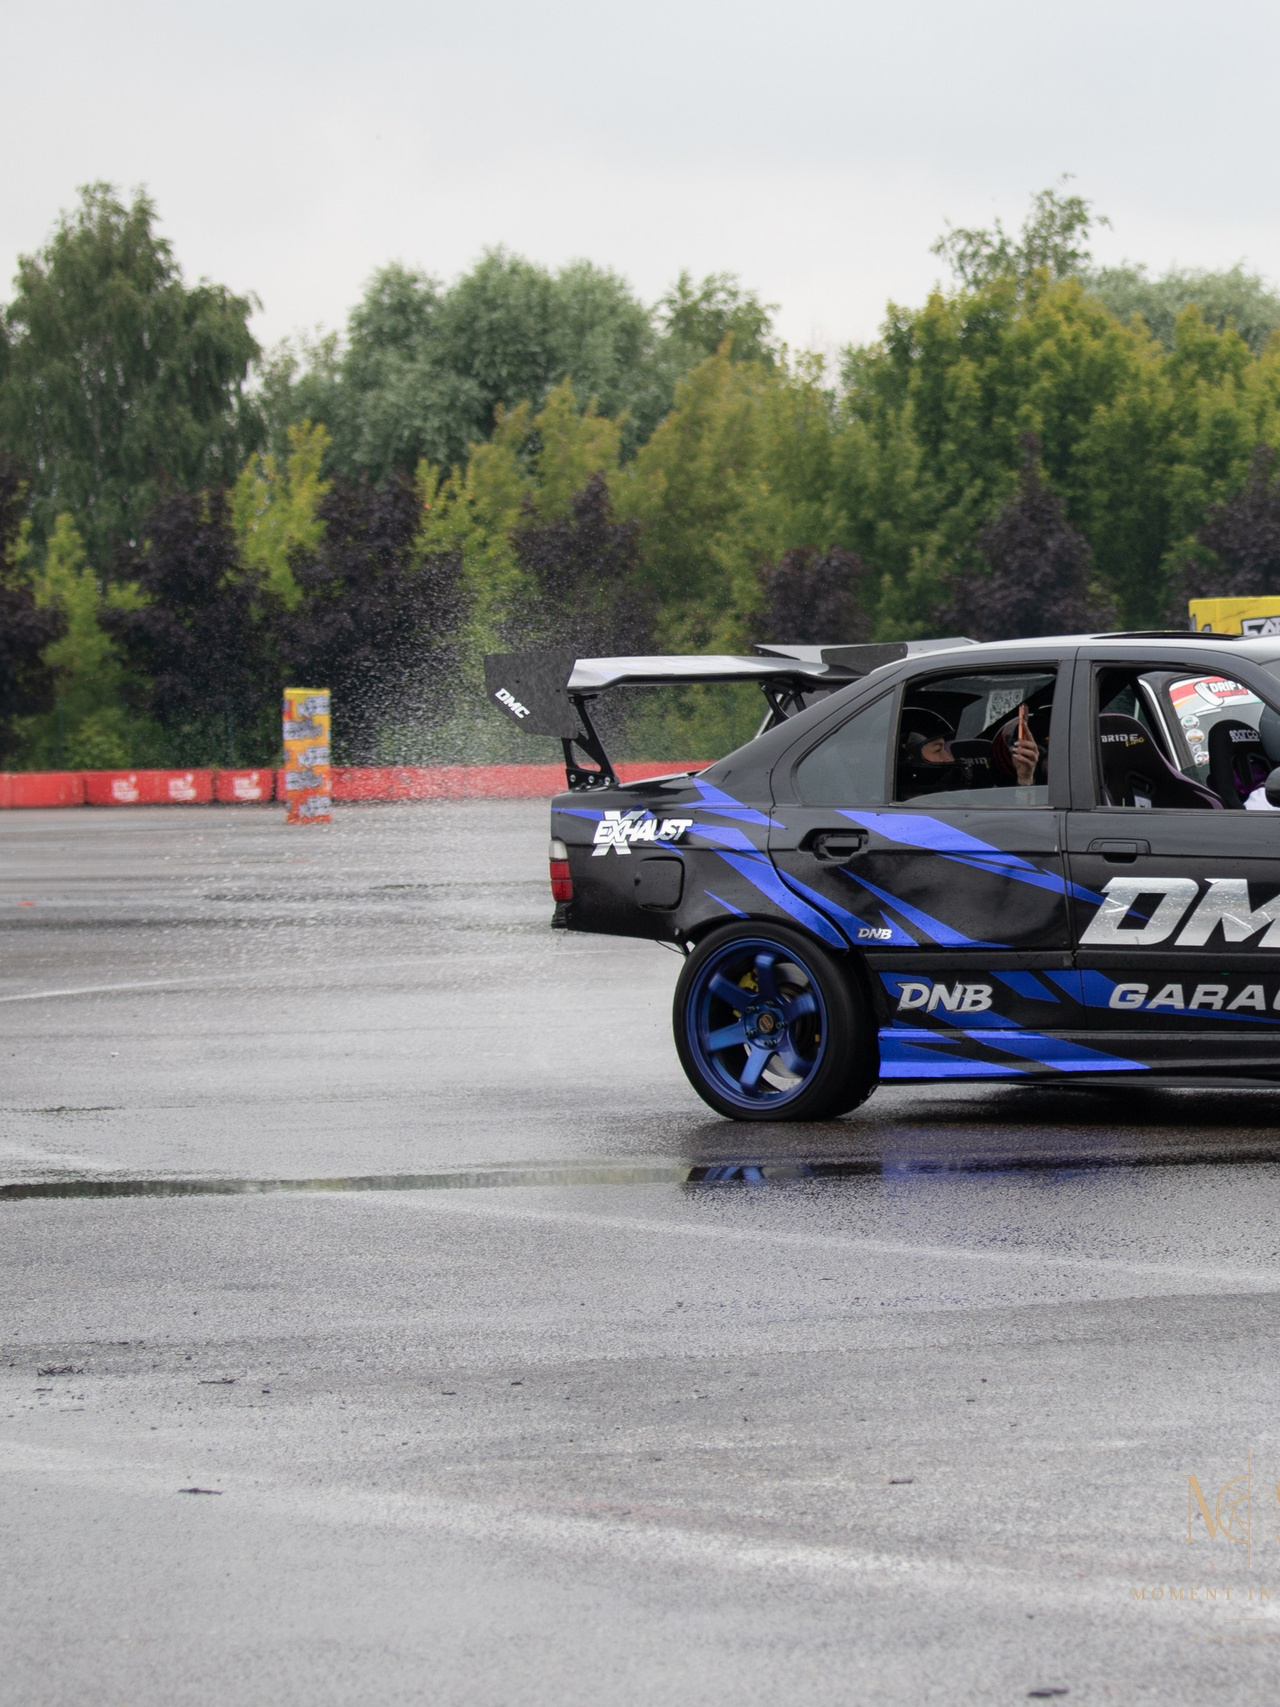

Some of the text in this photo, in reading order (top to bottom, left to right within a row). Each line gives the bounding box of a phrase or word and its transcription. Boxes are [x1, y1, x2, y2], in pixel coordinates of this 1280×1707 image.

[495, 688, 530, 718] DMC
[858, 928, 892, 940] DNB
[897, 981, 993, 1013] DNB
